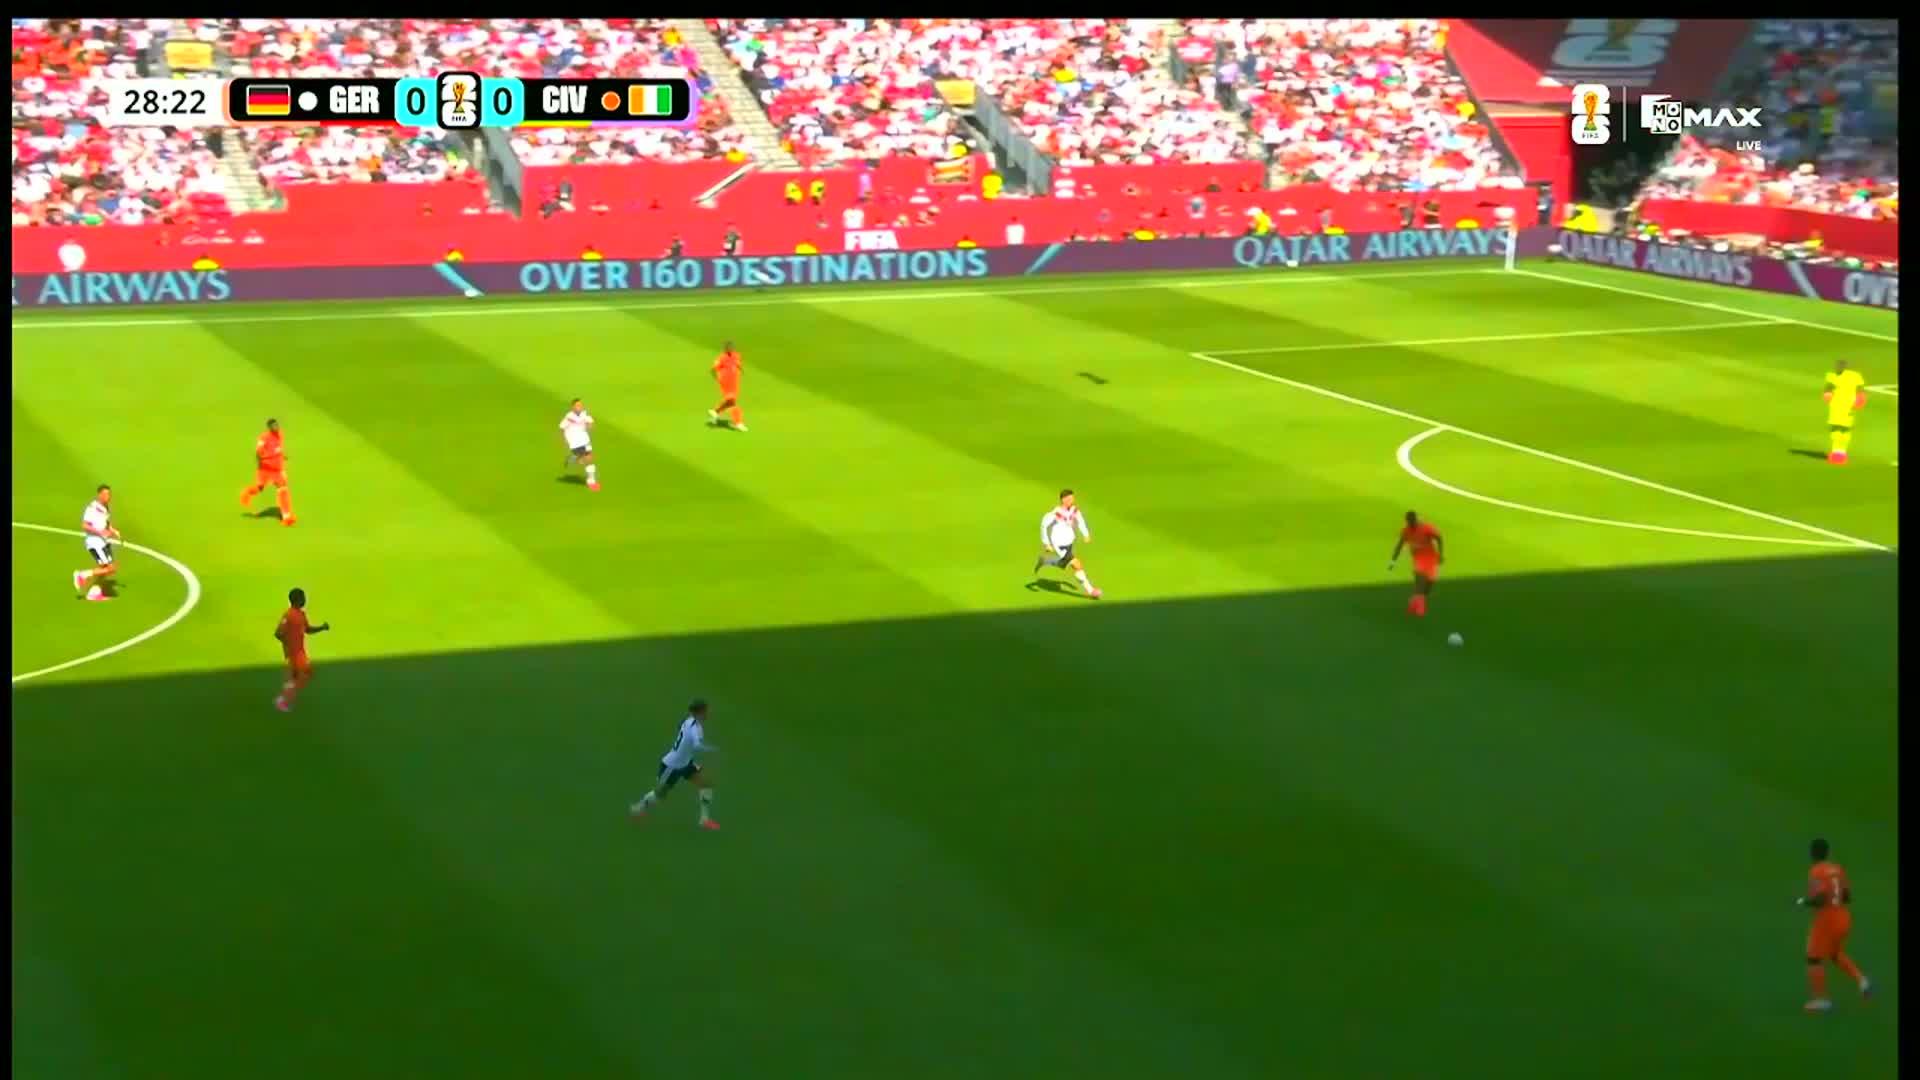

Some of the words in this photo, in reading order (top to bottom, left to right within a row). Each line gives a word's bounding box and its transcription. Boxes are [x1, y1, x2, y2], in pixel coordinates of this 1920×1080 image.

[1233, 234, 1351, 268] QATAR
[38, 269, 231, 305] AIRWAYS
[520, 260, 629, 292] OVER
[640, 258, 702, 289] 160
[711, 248, 988, 288] DESTINATIONS
